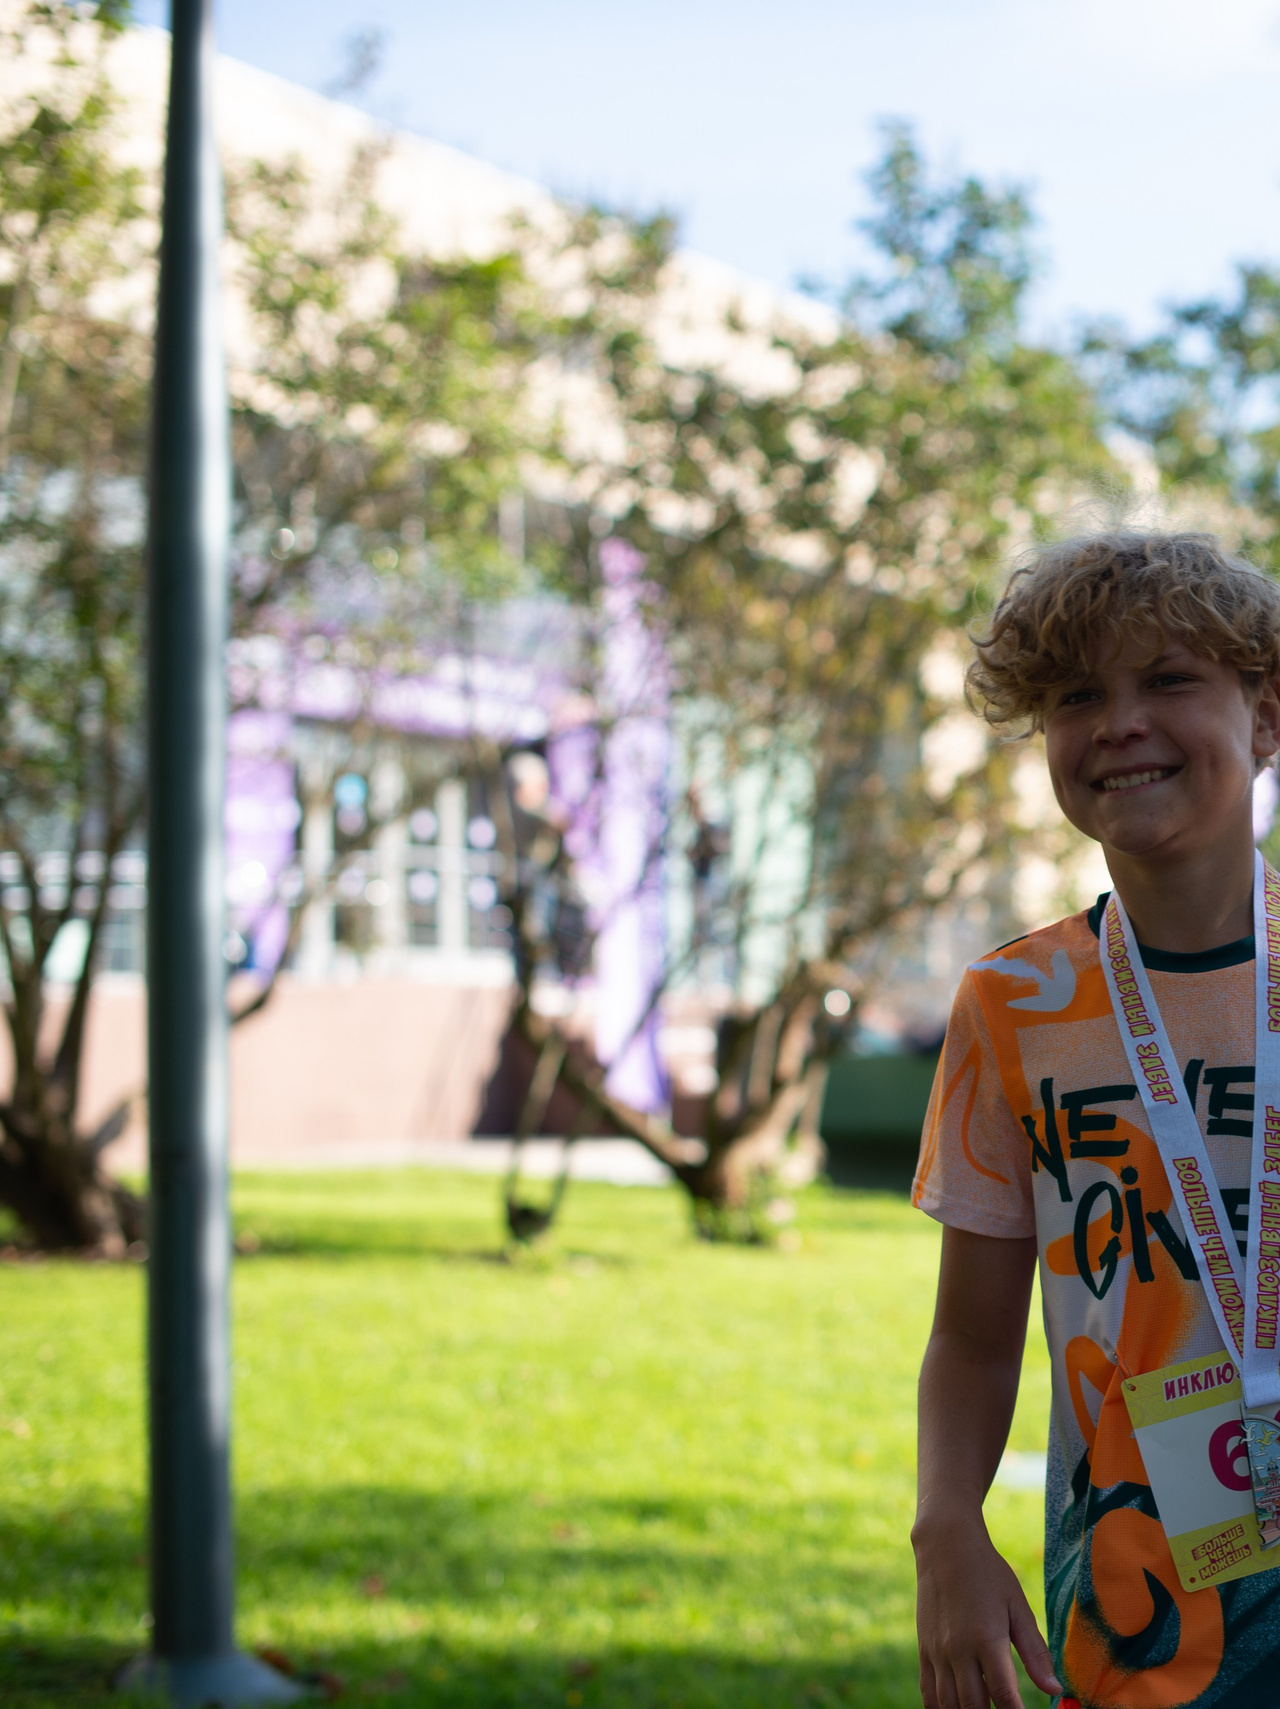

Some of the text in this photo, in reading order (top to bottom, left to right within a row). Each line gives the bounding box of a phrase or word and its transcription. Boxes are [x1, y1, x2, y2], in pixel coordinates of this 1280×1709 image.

[1105, 898, 1178, 1105] ИНКЛЮЗИВНЫЙ ЗАБЕГ
[1173, 1156, 1221, 1237] БОЛЬШЕ
[1199, 1236, 1234, 1277] ЧЕМ
[1200, 1525, 1244, 1556] БОЛЬШЕ
[1209, 1541, 1235, 1561] ЧЕМ
[1200, 1546, 1252, 1580] МОЖЕШЬ
